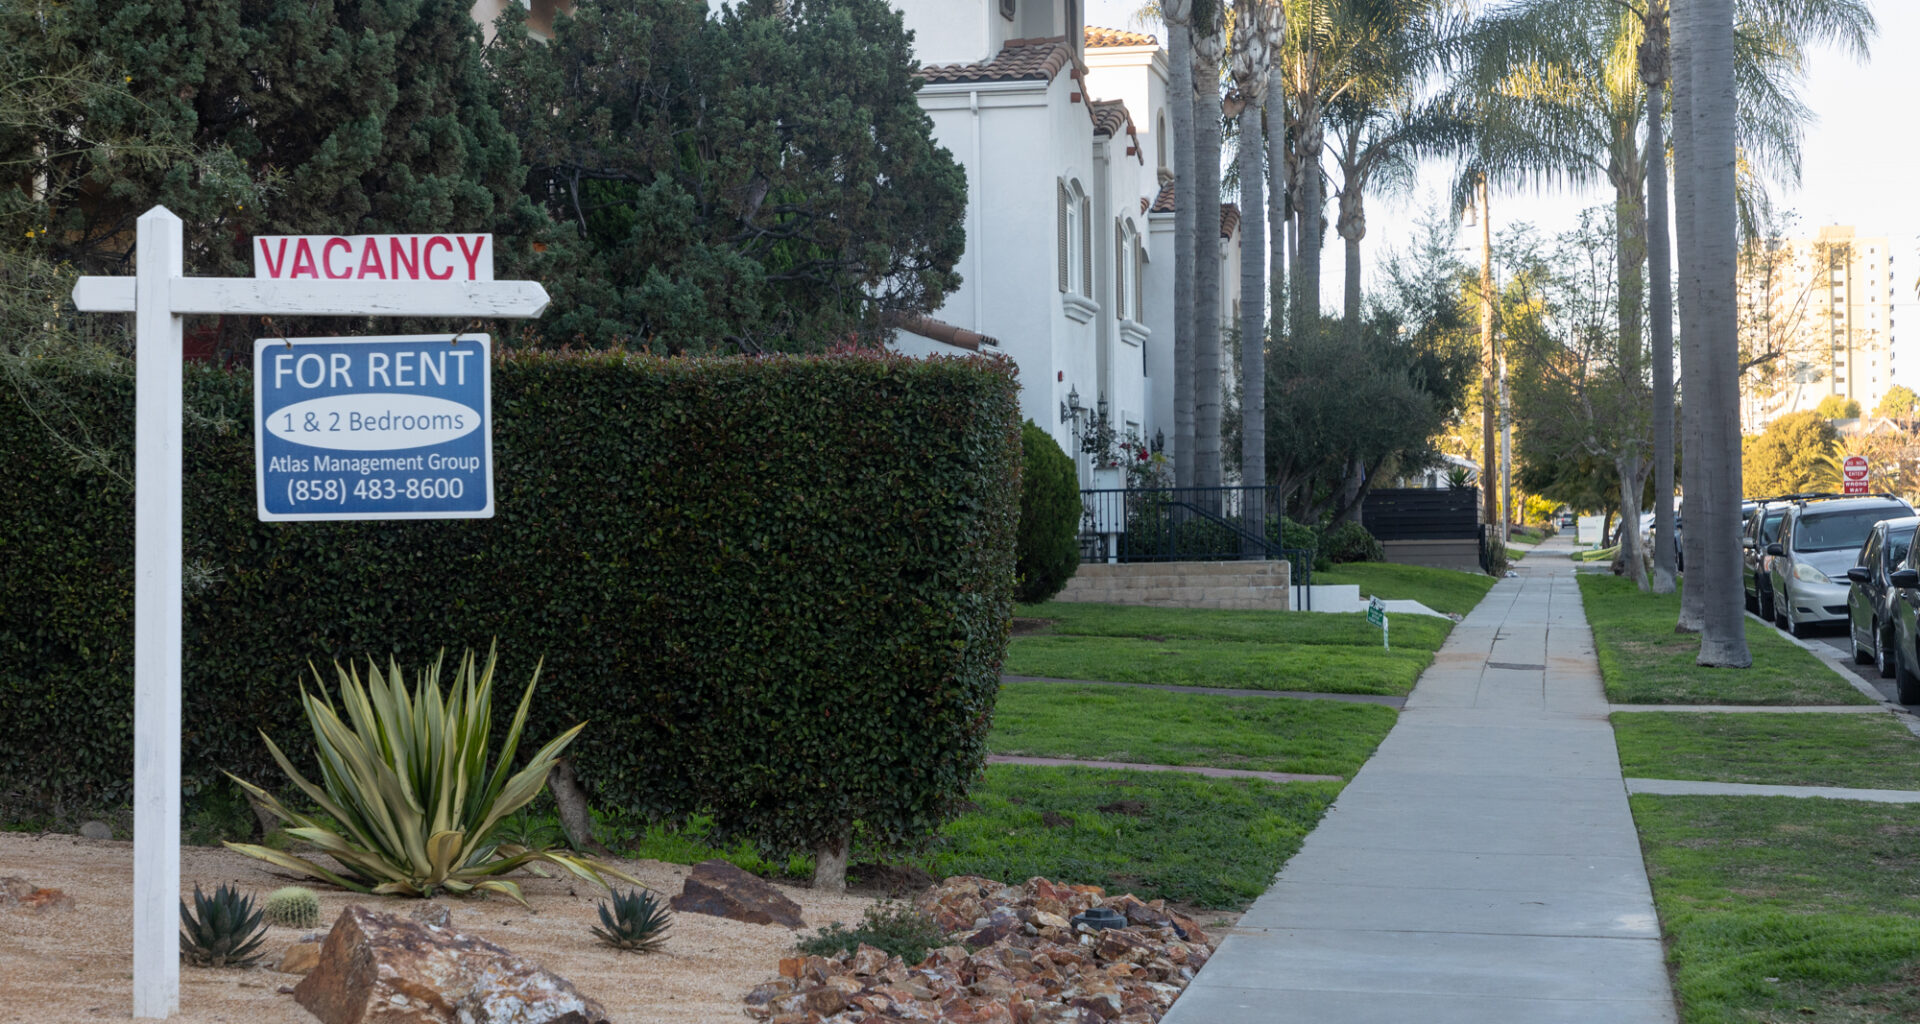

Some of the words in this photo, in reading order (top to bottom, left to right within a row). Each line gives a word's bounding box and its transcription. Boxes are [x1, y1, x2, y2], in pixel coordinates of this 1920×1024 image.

[259, 236, 485, 280] VACANCY
[274, 354, 353, 389] FOR
[368, 350, 474, 387] RENT
[284, 413, 295, 432] 1
[303, 412, 321, 432] &
[329, 412, 341, 431] 2
[349, 410, 464, 431] Bedrooms
[269, 455, 309, 473] Atlas
[313, 454, 423, 475] Management
[428, 453, 480, 473] Group
[287, 478, 347, 505] (858)
[353, 477, 464, 499] 483-8600
